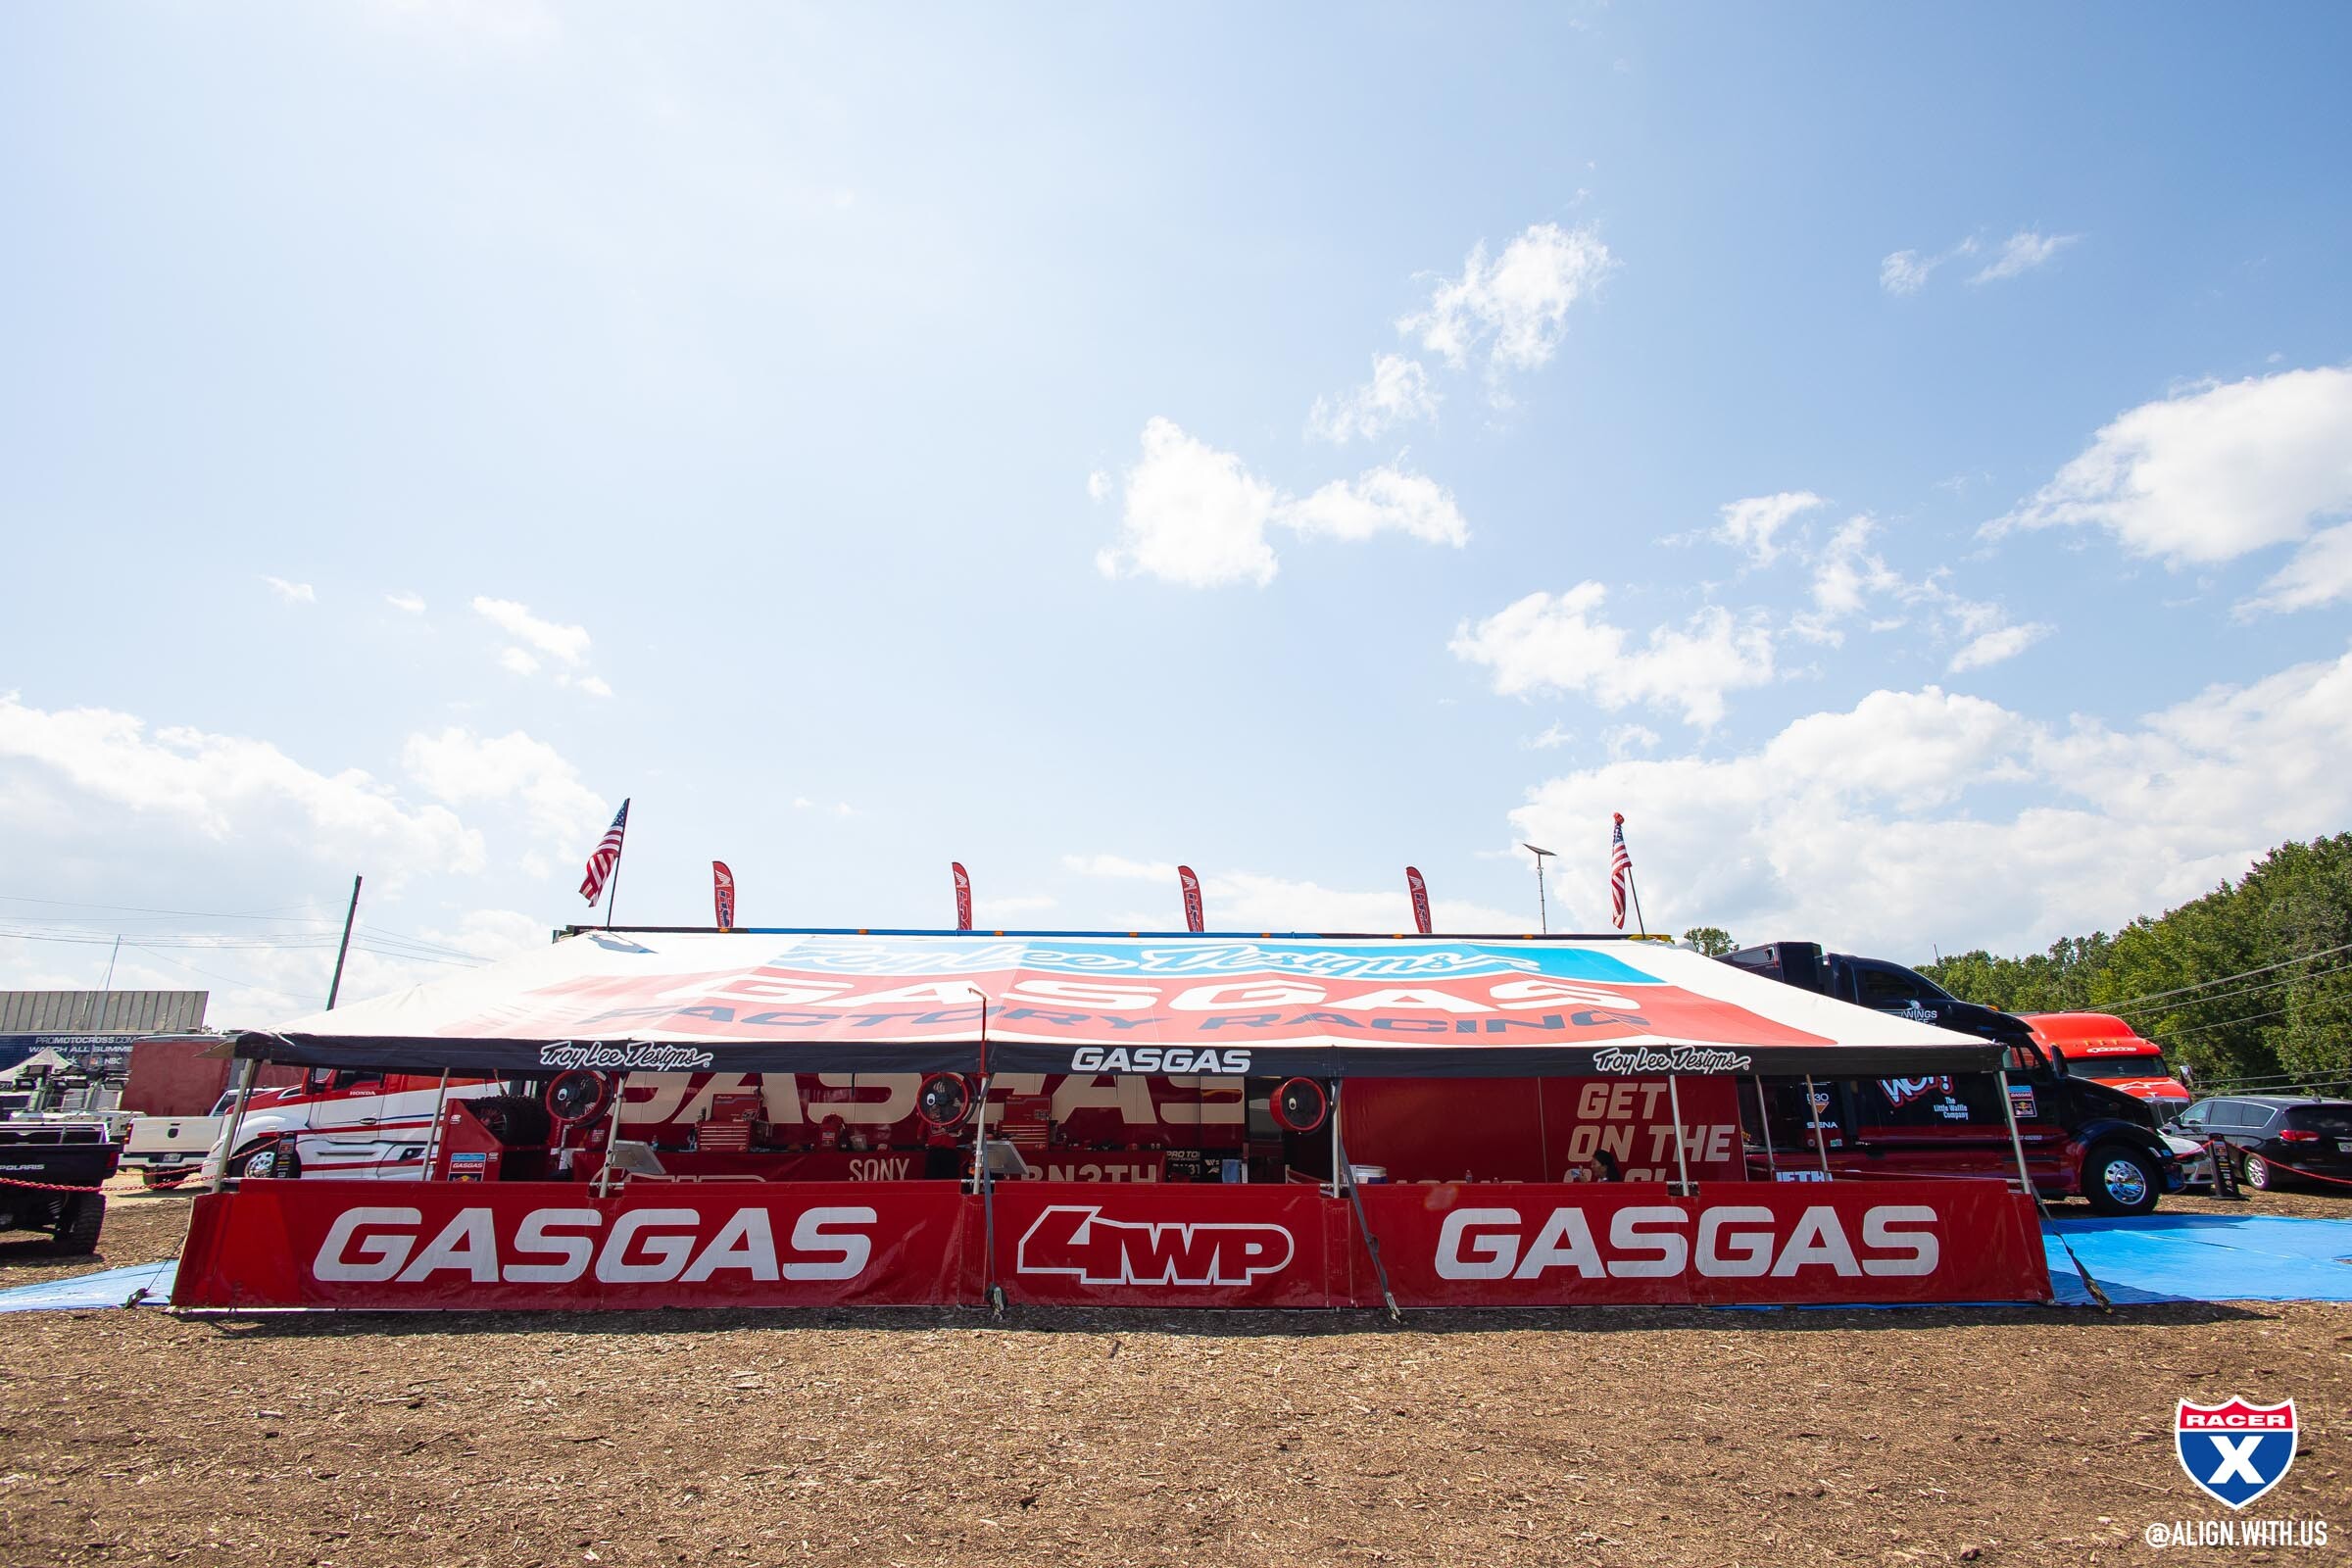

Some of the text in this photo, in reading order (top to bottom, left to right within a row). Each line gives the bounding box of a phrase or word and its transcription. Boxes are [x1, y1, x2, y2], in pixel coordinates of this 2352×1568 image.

[654, 976, 1641, 1013] GASGAS
[574, 1000, 1651, 1035] FACTORY RACING
[1901, 1009, 1937, 1019] WINGS
[104, 1056, 123, 1065] NBC
[540, 1041, 713, 1071] Troy Lee Designs
[1071, 1047, 1251, 1073] GASGAS
[1593, 1045, 1751, 1075] Troy Lee Designs
[1577, 1083, 1668, 1119] GET
[1568, 1125, 1736, 1162] ON THE
[849, 1158, 910, 1181] SONY
[313, 1206, 877, 1282] GASGAS
[1017, 1205, 1295, 1285] 4WP
[1434, 1205, 1939, 1279] GASGAS
